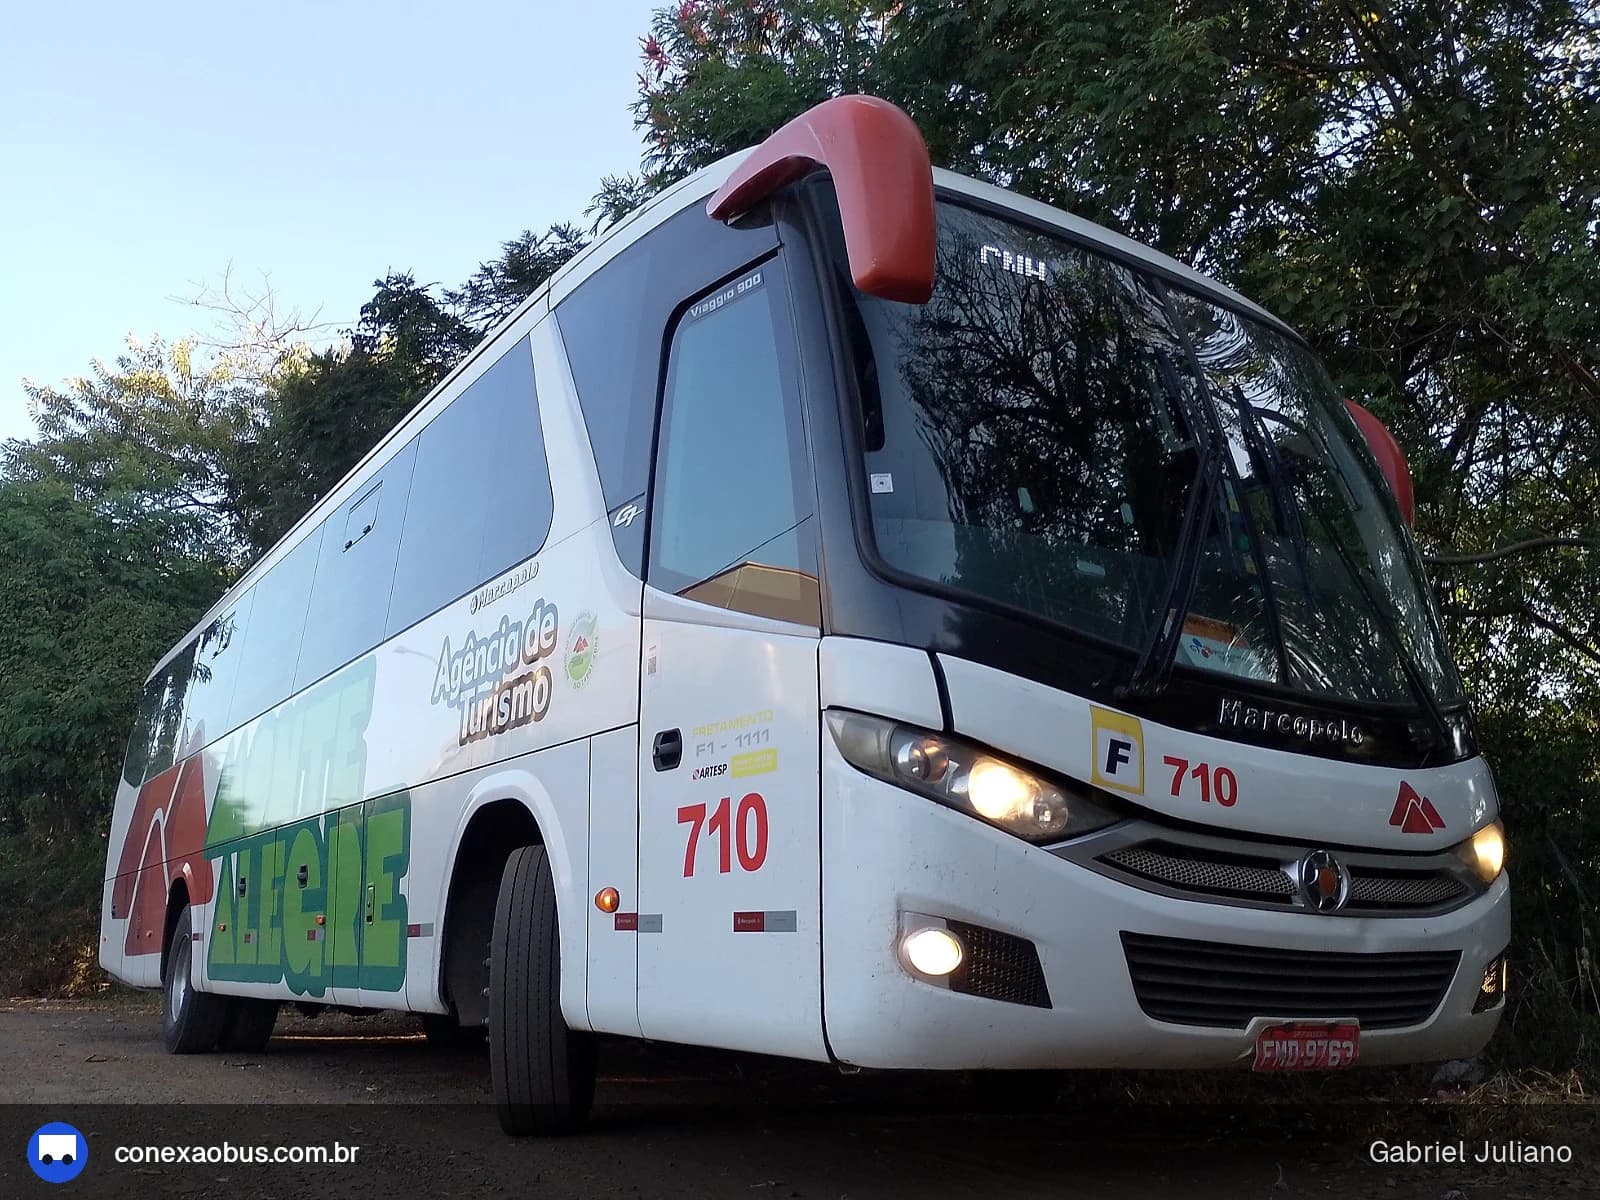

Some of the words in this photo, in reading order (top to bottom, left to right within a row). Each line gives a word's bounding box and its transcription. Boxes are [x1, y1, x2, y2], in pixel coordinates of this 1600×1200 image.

[691, 289, 735, 317] Viaggio
[737, 272, 762, 294] 900
[476, 560, 540, 610] Marcopolo
[432, 616, 523, 704] Agência
[523, 600, 558, 663] de
[459, 667, 552, 745] Turismo
[692, 709, 774, 737] FRETAMENTO
[1219, 698, 1364, 744] Marcopolo
[735, 728, 770, 748] 1111
[1105, 738, 1132, 775] F
[699, 763, 728, 779] ARTESP
[1163, 756, 1239, 807] 710
[677, 793, 769, 877] 710
[206, 793, 410, 997] ALEGRE
